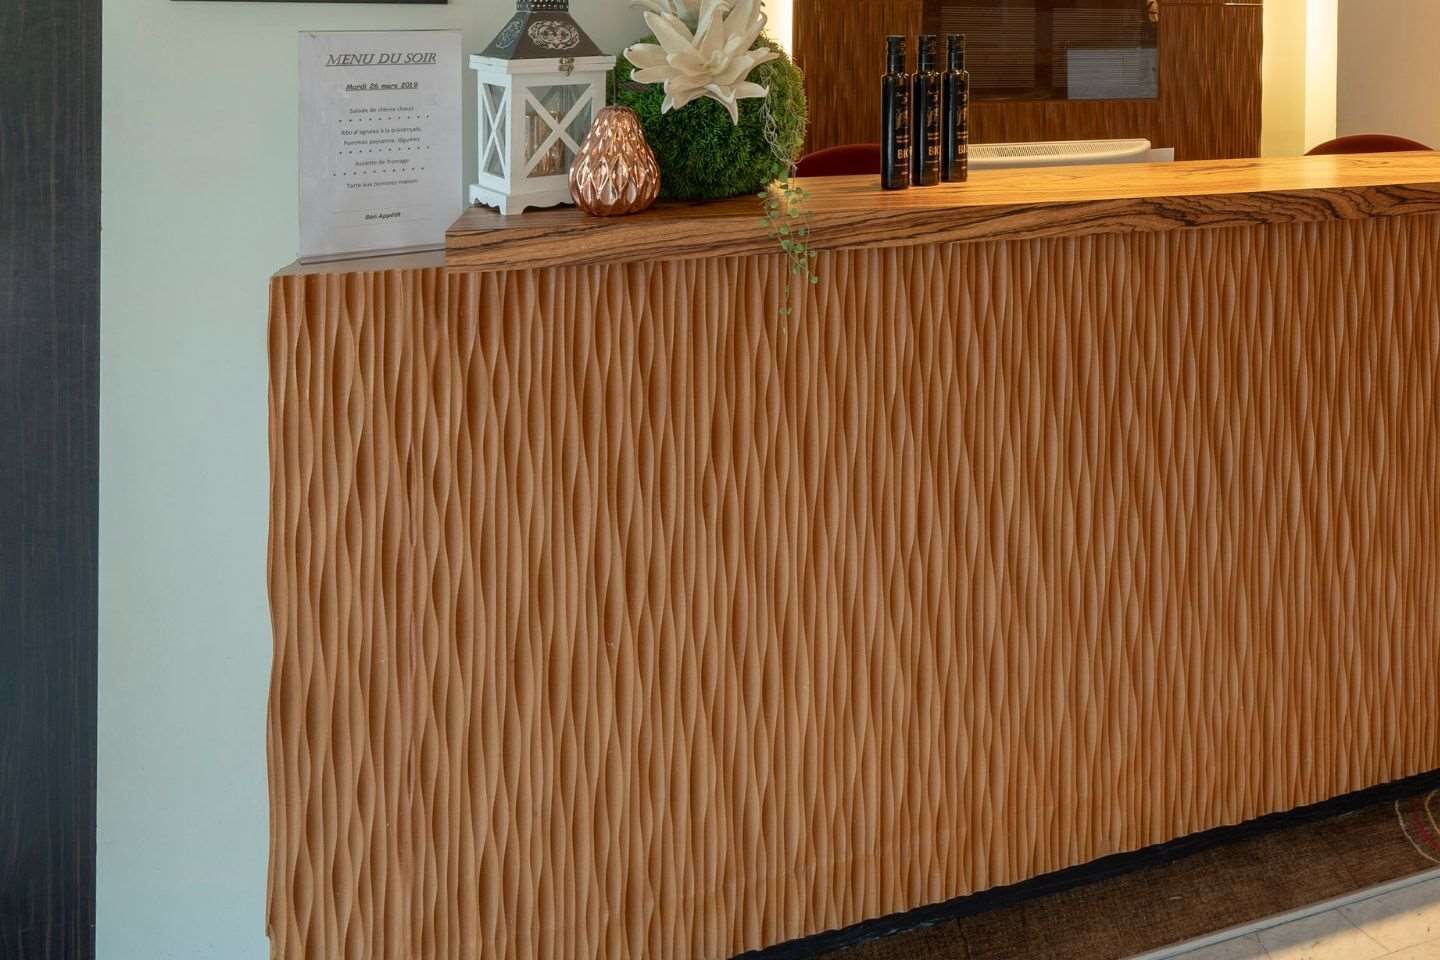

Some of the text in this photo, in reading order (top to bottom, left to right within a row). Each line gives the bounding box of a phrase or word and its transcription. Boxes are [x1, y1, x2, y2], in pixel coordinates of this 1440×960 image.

[327, 52, 437, 65] MENU DU SOIR
[346, 83, 367, 91] Mardi
